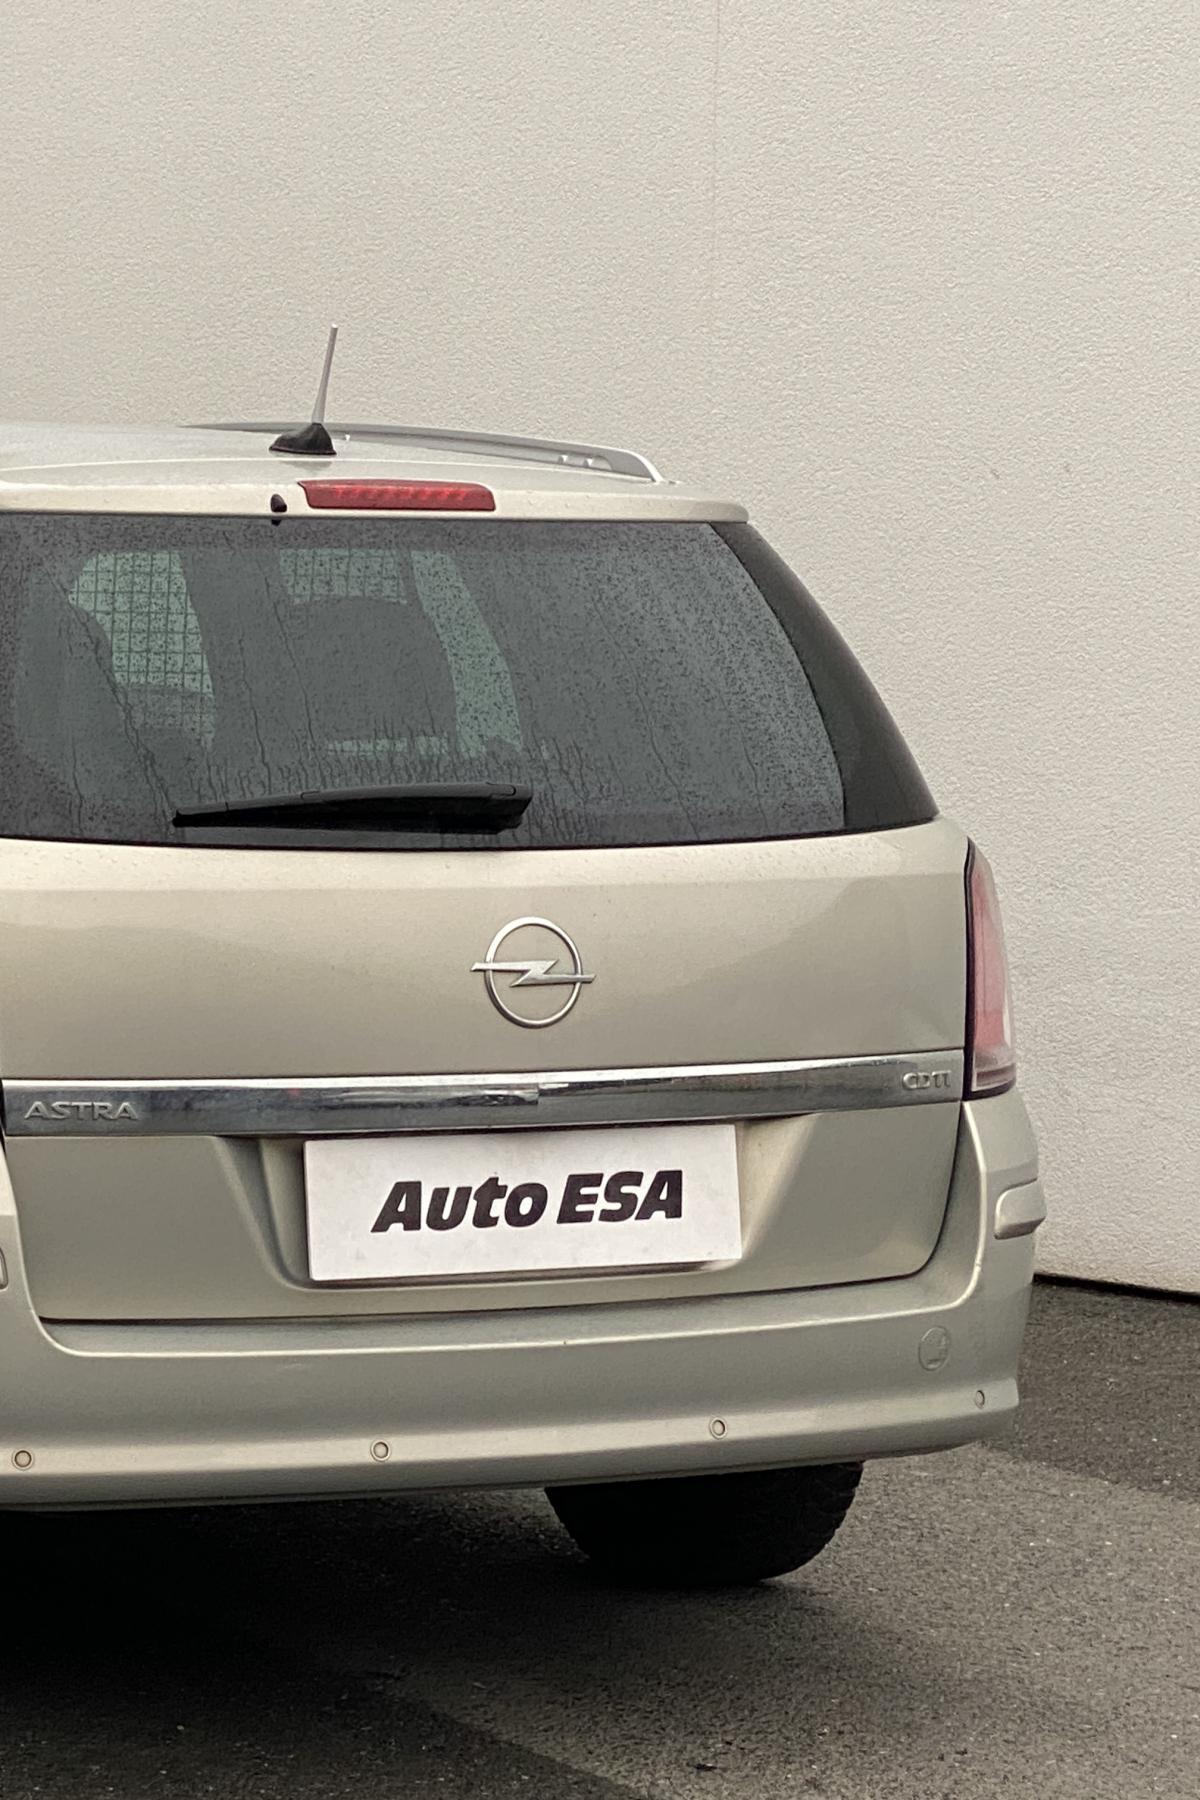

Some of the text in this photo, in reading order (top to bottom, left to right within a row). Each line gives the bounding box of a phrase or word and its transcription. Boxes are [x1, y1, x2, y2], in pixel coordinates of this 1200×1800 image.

[24, 1101, 139, 1120] ASTRA
[370, 1170, 684, 1233] Auto ESA
